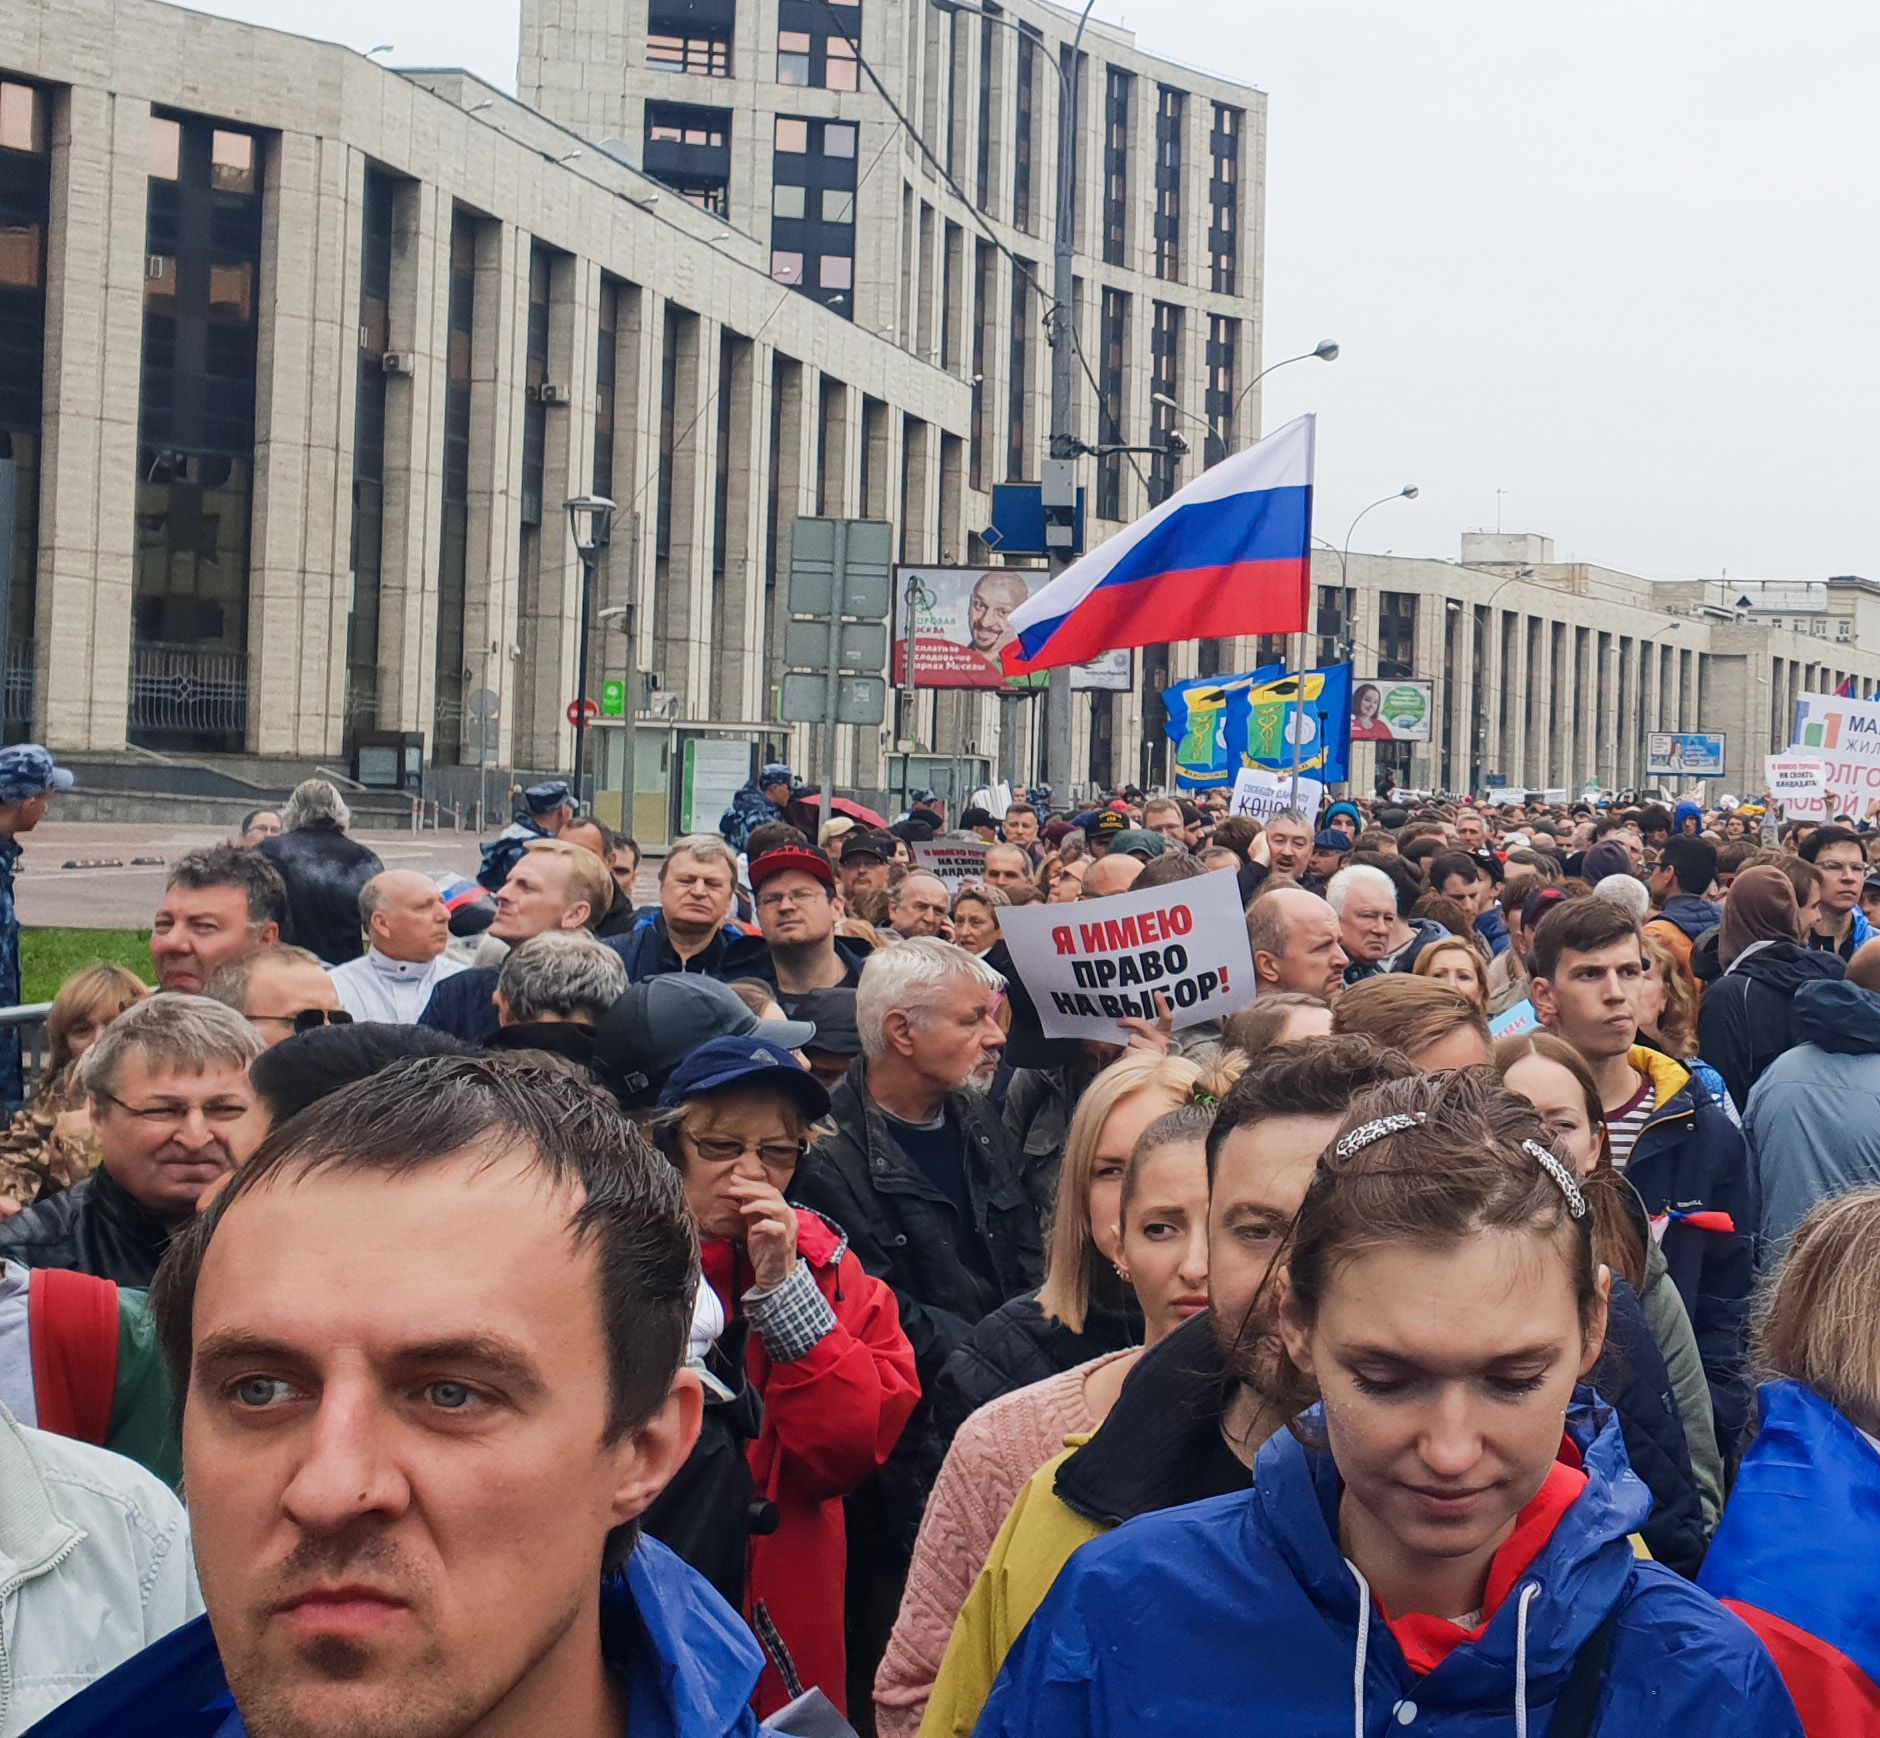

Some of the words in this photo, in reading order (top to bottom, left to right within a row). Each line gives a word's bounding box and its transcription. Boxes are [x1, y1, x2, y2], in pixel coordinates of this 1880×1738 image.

[1052, 926, 1077, 955] Я
[1079, 904, 1194, 954] ИМЕЮ
[1072, 944, 1188, 988] ПРАВО
[1051, 991, 1100, 1018] НА
